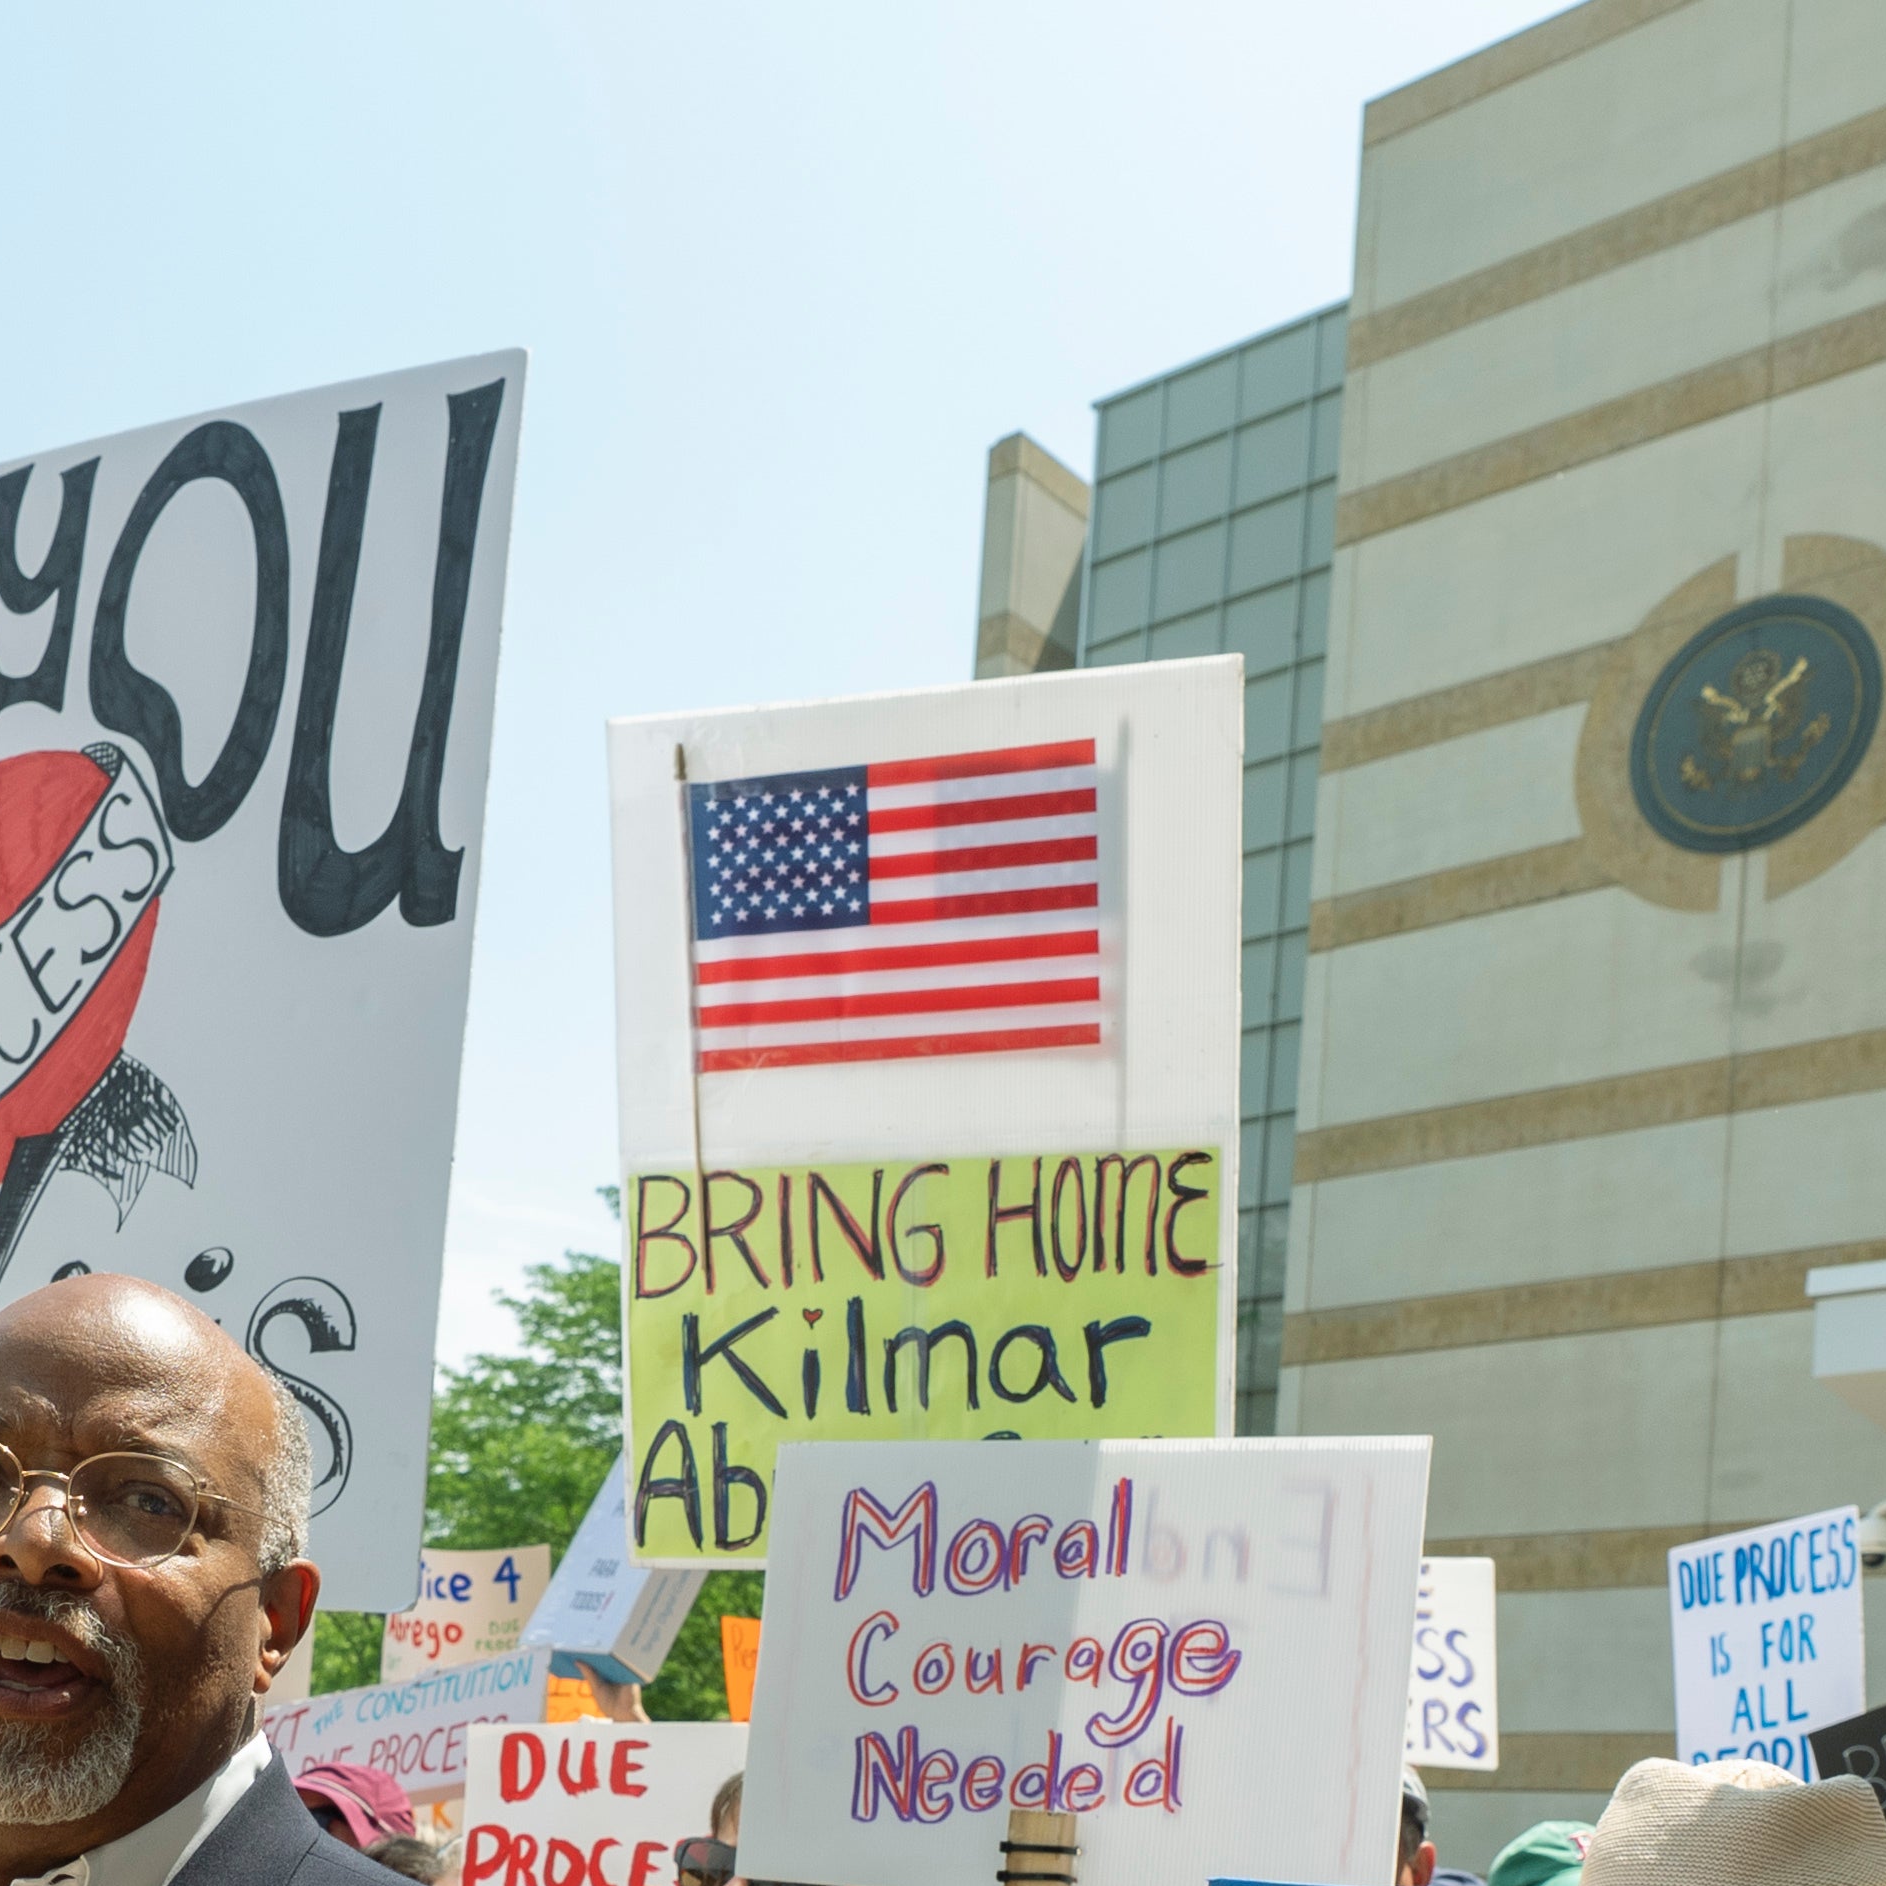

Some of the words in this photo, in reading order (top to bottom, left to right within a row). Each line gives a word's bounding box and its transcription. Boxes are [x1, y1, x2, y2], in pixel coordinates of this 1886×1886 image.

[635, 1162, 950, 1299] BRING
[986, 1150, 1220, 1282] HOME
[681, 1296, 1151, 1420] Kilmar
[493, 1555, 522, 1603] 4
[834, 1477, 1133, 1602] Moral
[1678, 1552, 1726, 1611] DUE
[1734, 1517, 1858, 1605] PROCESS
[846, 1609, 1243, 1749] Courage
[1710, 1631, 1732, 1678] IS
[1760, 1612, 1817, 1669] FOR
[1731, 1679, 1809, 1734] ALL
[500, 1732, 651, 1803] DUE
[851, 1715, 1183, 1824] Needed
